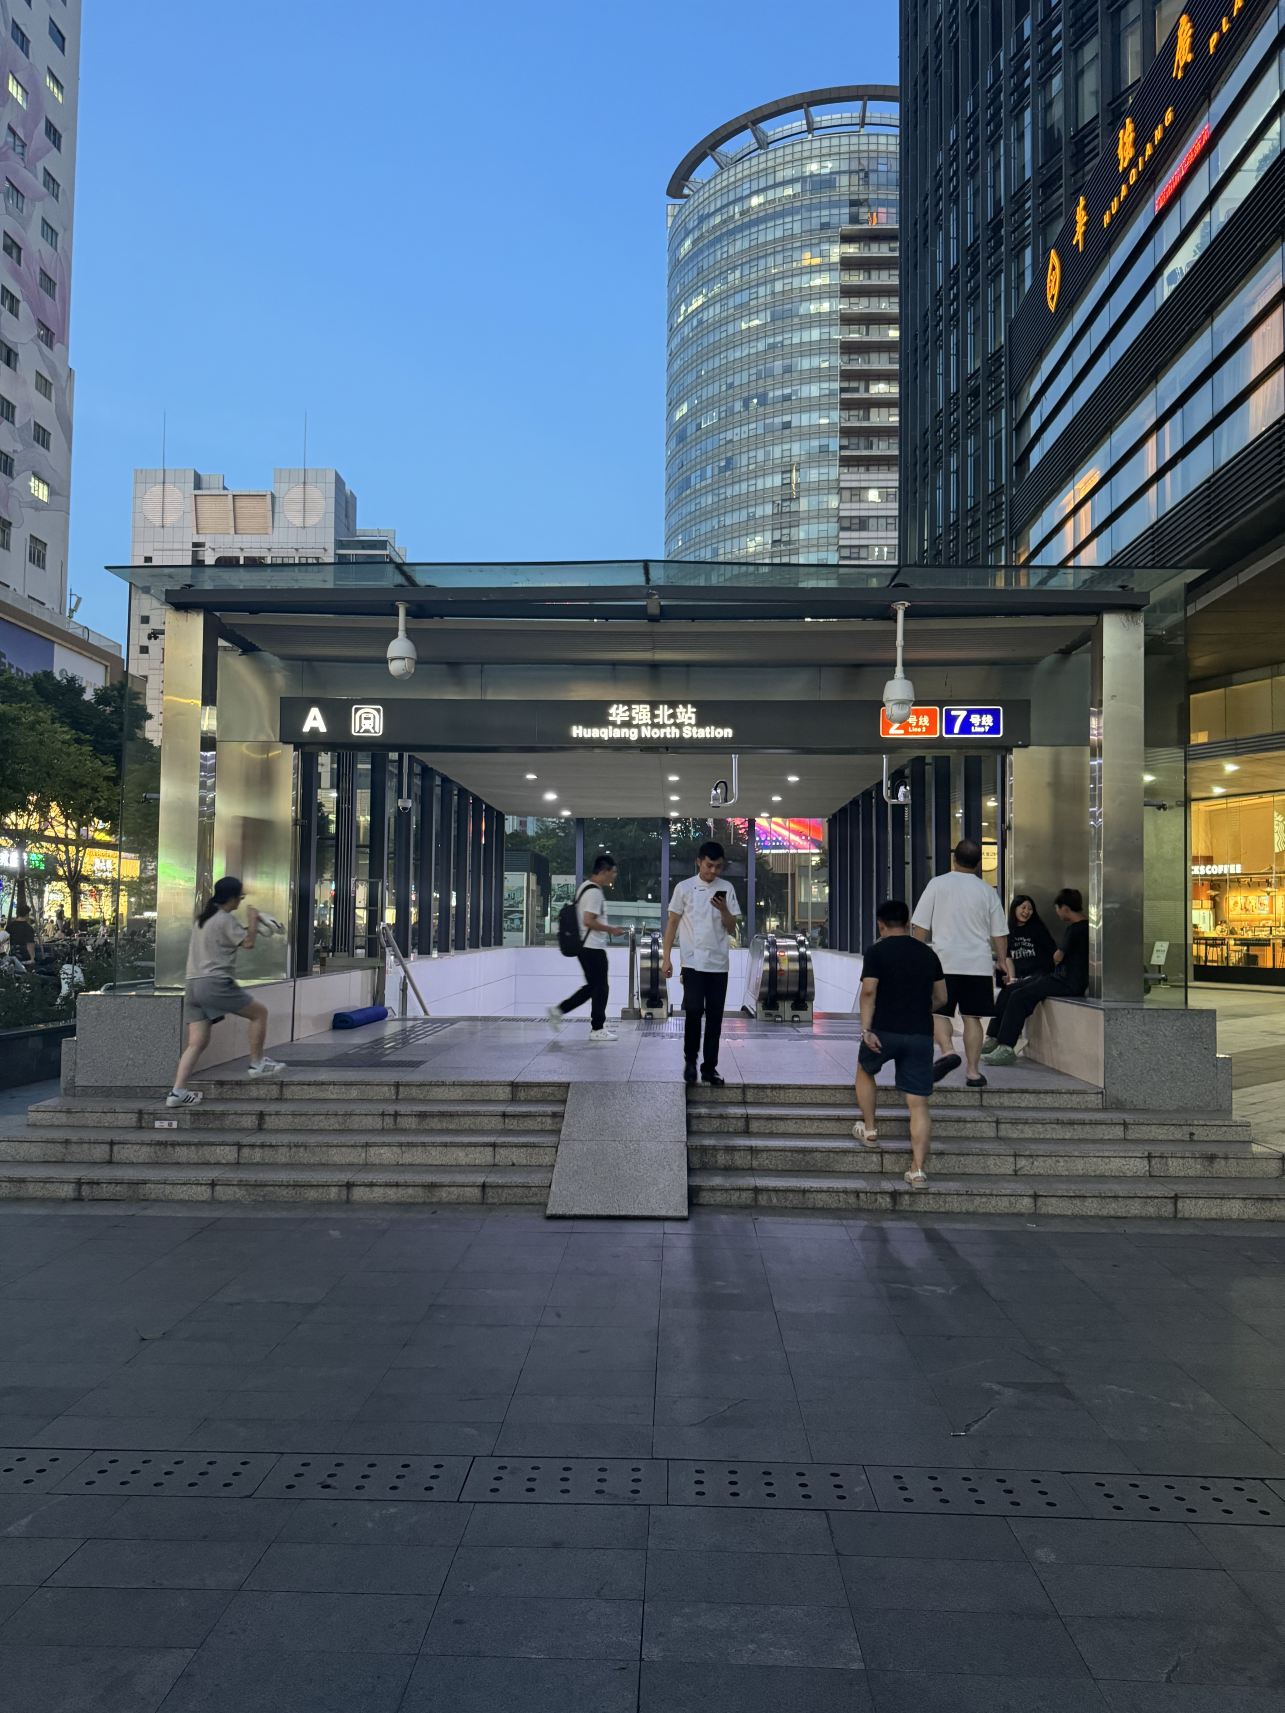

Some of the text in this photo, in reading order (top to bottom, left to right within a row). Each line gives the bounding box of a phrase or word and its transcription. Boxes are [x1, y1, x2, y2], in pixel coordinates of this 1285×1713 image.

[1103, 106, 1175, 228] HUAQIANG
[302, 707, 327, 733] A
[608, 703, 697, 725] 华强北站
[571, 725, 734, 741] Huaqiang North Station
[1205, 864, 1242, 875] COFFEE
